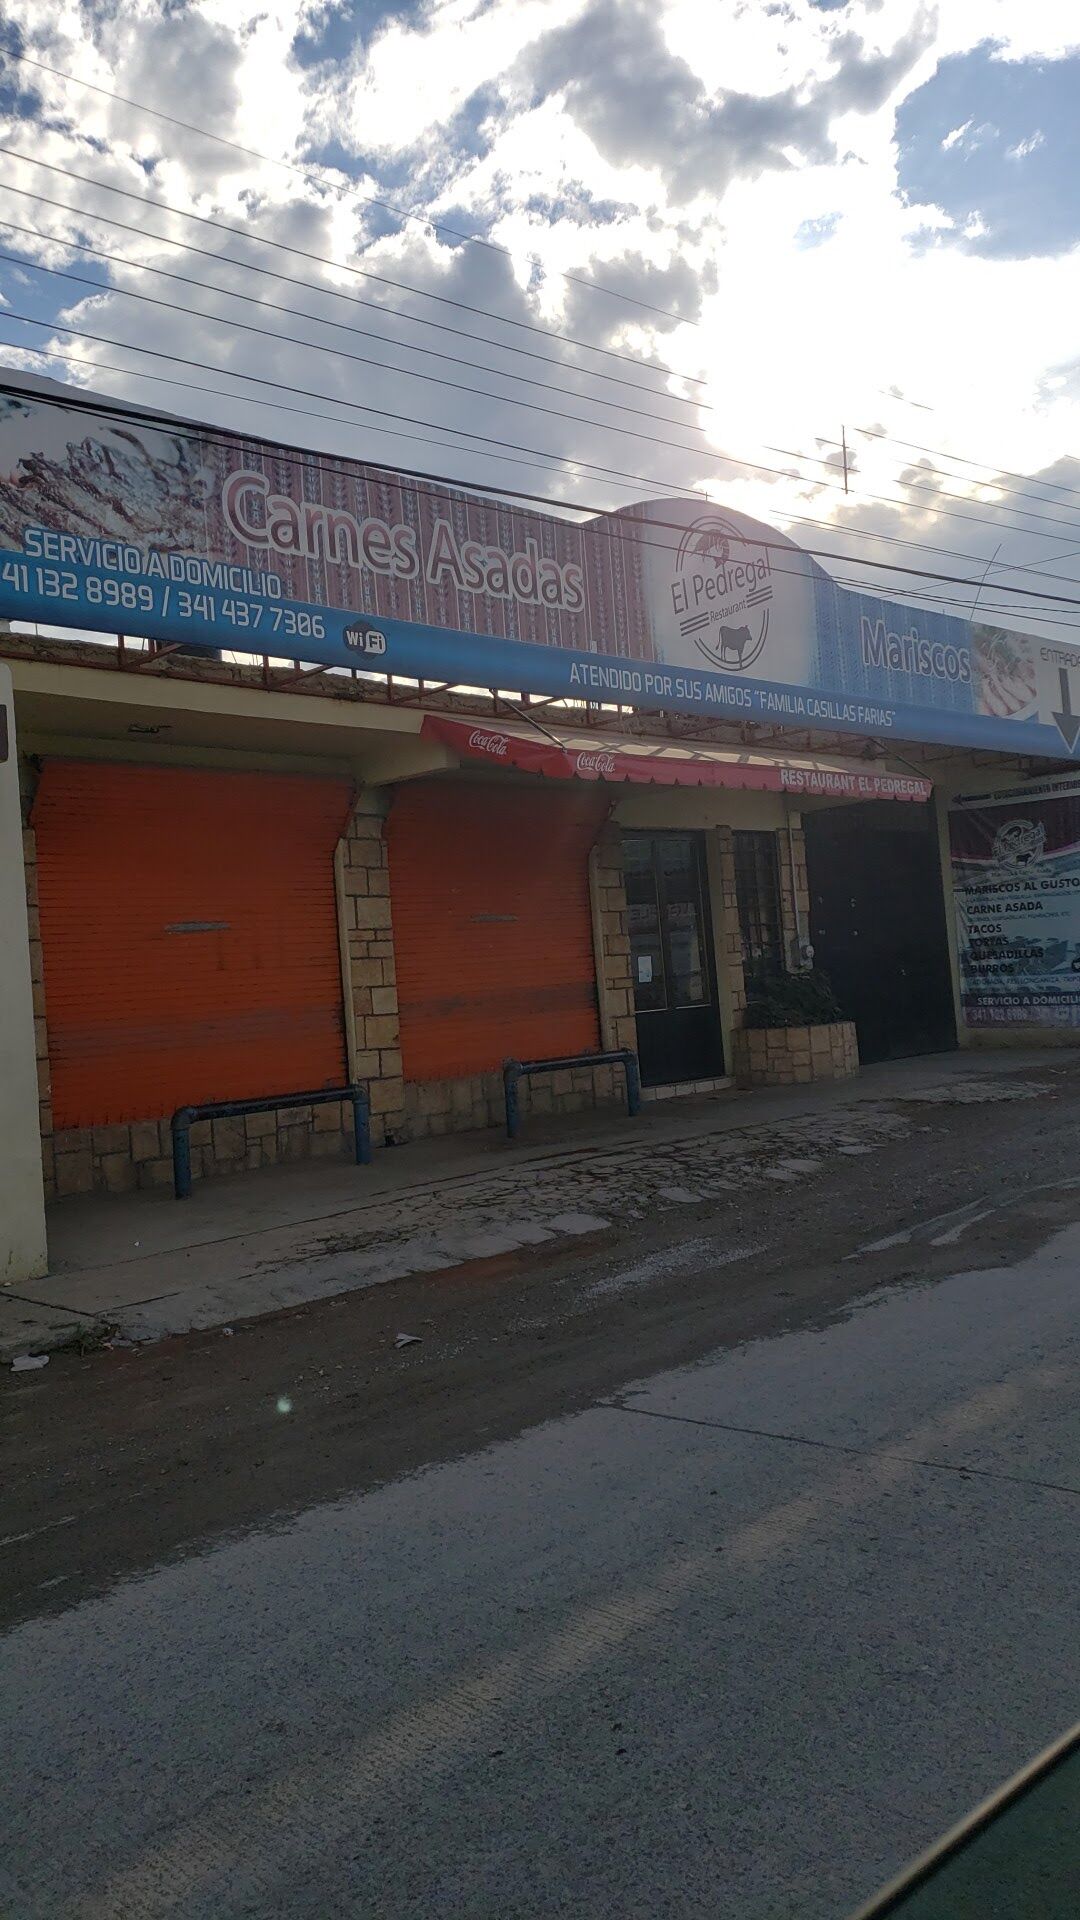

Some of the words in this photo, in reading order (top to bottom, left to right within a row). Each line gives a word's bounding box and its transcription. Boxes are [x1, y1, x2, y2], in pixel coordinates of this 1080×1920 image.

[222, 470, 420, 579] Carnes
[427, 519, 584, 613] Asadas
[24, 529, 140, 574] SERVICIO
[147, 552, 166, 579] A
[169, 554, 281, 599] DOMICILIO
[671, 578, 688, 615] El
[693, 547, 771, 606] Pedregal
[36, 567, 78, 601] 132
[85, 576, 154, 612] 8989
[161, 585, 170, 617] /
[178, 592, 215, 622] 341
[221, 600, 262, 628] 437
[270, 607, 325, 639] 7306
[709, 600, 747, 622] Restaurant
[860, 616, 971, 683] Mariscos
[569, 662, 642, 693] ATENDIDO
[645, 673, 673, 696] POR
[675, 678, 702, 700] SUS
[704, 681, 752, 708] AMIGOS
[806, 698, 857, 722] CASILLAS
[780, 769, 855, 791] RESTAURANT
[859, 777, 873, 791] EL
[874, 777, 928, 796] PEDREGAL
[965, 882, 1020, 896] MARISCOS
[1024, 881, 1038, 892] AL
[1040, 877, 1080, 890] GUSTO
[966, 904, 1002, 915] CARNE
[1005, 901, 1043, 912] ASADA
[968, 924, 1002, 934] TACOS
[969, 936, 1009, 947] TORTAS
[970, 948, 1043, 961] QUESADILLAS
[970, 964, 1014, 974] BURROS
[977, 996, 1020, 1006] SERVICIO
[1023, 996, 1030, 1005] A
